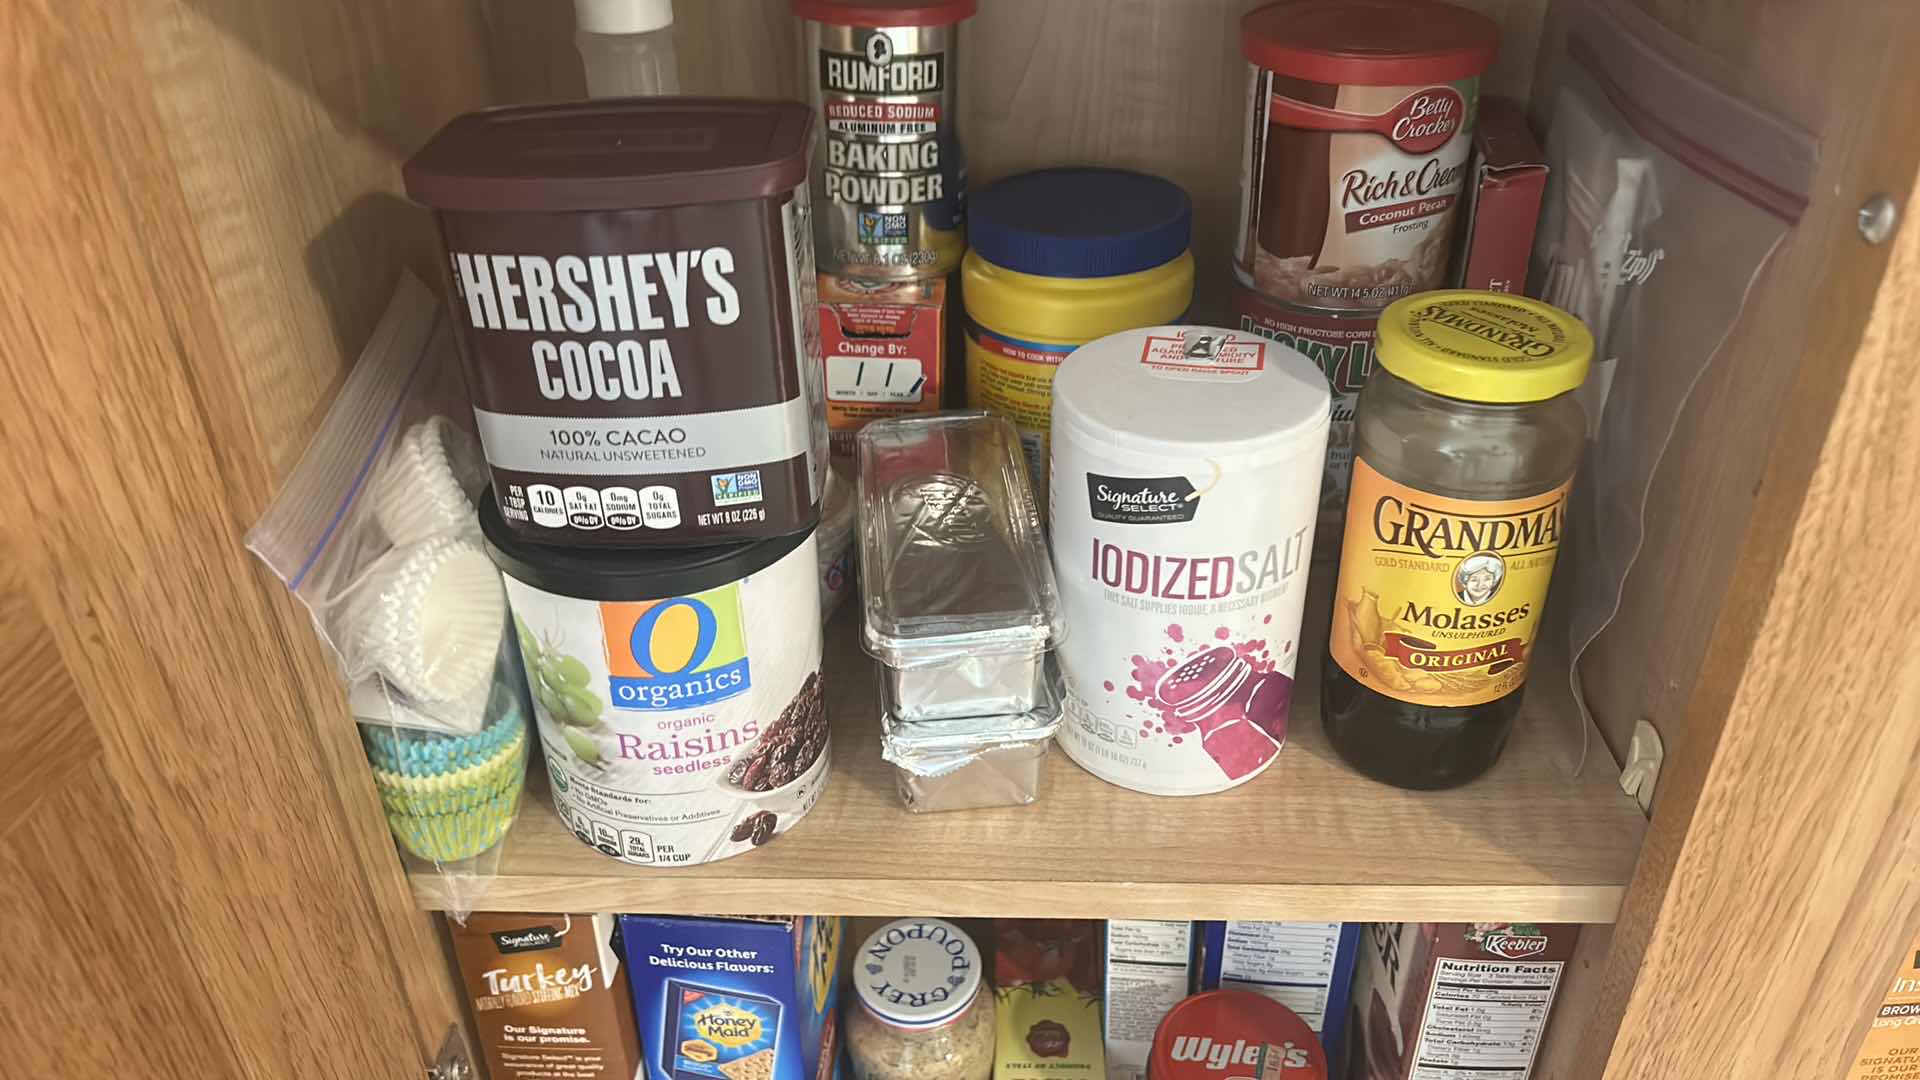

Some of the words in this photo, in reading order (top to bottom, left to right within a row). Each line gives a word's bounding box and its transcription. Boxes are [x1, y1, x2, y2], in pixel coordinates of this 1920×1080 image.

[828, 57, 938, 92] RUMFORD
[830, 103, 883, 119] REDUCED
[888, 105, 935, 119] SODIUM
[1410, 95, 1454, 120] Betty
[837, 121, 896, 134] ALUMINUM
[901, 122, 926, 134] FREE
[1392, 116, 1457, 141] Crocker
[828, 138, 938, 172] BAKING
[825, 171, 943, 206] POWDER
[1342, 169, 1397, 209] Rich
[1400, 173, 1415, 197] &
[884, 215, 906, 223] NON
[1359, 206, 1415, 225] Coconut
[1418, 199, 1447, 214] Pecan
[1392, 218, 1429, 235] Frosting
[456, 246, 741, 334] HERSHEY'S
[1308, 282, 1328, 297] NET
[1331, 287, 1349, 298] WT
[1264, 317, 1276, 327] NO
[1277, 321, 1297, 332] HIGH
[1298, 326, 1344, 338] FRUCTOSE
[1345, 330, 1373, 338] CORN
[1419, 304, 1555, 358] GRANDMA'S
[838, 341, 885, 357] Change
[888, 343, 907, 356] BY:
[532, 339, 682, 400] COCOA
[549, 429, 600, 447] 100%
[606, 427, 687, 447] CACAO
[540, 448, 601, 462] NATURAL
[602, 446, 707, 462] UNSWEETENED
[737, 473, 756, 481] NON
[509, 484, 523, 497] PER
[536, 490, 555, 506] 10
[576, 491, 587, 502] 0g
[610, 491, 628, 502] 0mg
[652, 491, 664, 502] 0g
[1096, 484, 1180, 510] Signature
[503, 505, 529, 521] SERVING
[533, 506, 564, 515] CALORIES
[569, 502, 582, 511] SAT
[584, 503, 598, 511] FAT
[606, 503, 637, 511] SODIUM
[648, 502, 672, 510] TOTAL
[1121, 503, 1176, 512] SELECT
[646, 510, 677, 520] SUGARS
[697, 513, 711, 526] NET
[711, 511, 723, 525] WT
[725, 511, 731, 524] 8
[731, 510, 741, 523] OZ
[1096, 512, 1126, 520] QUALITY
[1128, 513, 1185, 521] GUARANTEED
[1091, 537, 1234, 601] IODIZED
[1235, 525, 1308, 595] SALT
[1375, 556, 1397, 569] GOLD
[1397, 559, 1450, 573] STANDARD
[1103, 588, 1119, 605] THIS
[1120, 593, 1139, 609] SALT
[1139, 598, 1178, 616] SUPPLIES
[1401, 601, 1531, 630] Molasses
[1431, 627, 1506, 639] UNSULPHURED
[1410, 643, 1509, 667] ORIGINAL
[618, 668, 742, 708] organics
[657, 713, 715, 731] organic
[617, 718, 760, 761] Raisins
[653, 755, 731, 776] seedless
[591, 786, 632, 803] Standards
[614, 809, 669, 822] Preservatives
[681, 809, 721, 820] Additives
[656, 845, 674, 853] PER
[659, 854, 671, 862] 1/4
[672, 853, 691, 862] CUP
[501, 933, 550, 948] Signature
[868, 923, 970, 971] POUPON
[1487, 936, 1547, 953] Keebler
[660, 943, 684, 957] Try
[686, 946, 713, 957] Our
[715, 947, 758, 960] Other
[649, 955, 713, 970] Delicious
[716, 961, 775, 974] Flavors:
[1441, 961, 1510, 973] Nutrition
[1514, 965, 1557, 974] Facts
[482, 962, 598, 996] Turkey
[870, 980, 950, 1008] GREY
[697, 1013, 756, 1029] Honey
[504, 1024, 526, 1034] Our
[528, 1025, 586, 1036] Signature
[708, 1026, 749, 1038] Maid
[516, 1035, 537, 1043] our
[539, 1035, 592, 1044] promise.
[1171, 1036, 1308, 1070] Wyle's
[1888, 1047, 1919, 1056] OUR
[1871, 1066, 1884, 1074] IS
[1888, 1065, 1918, 1073] OUR
